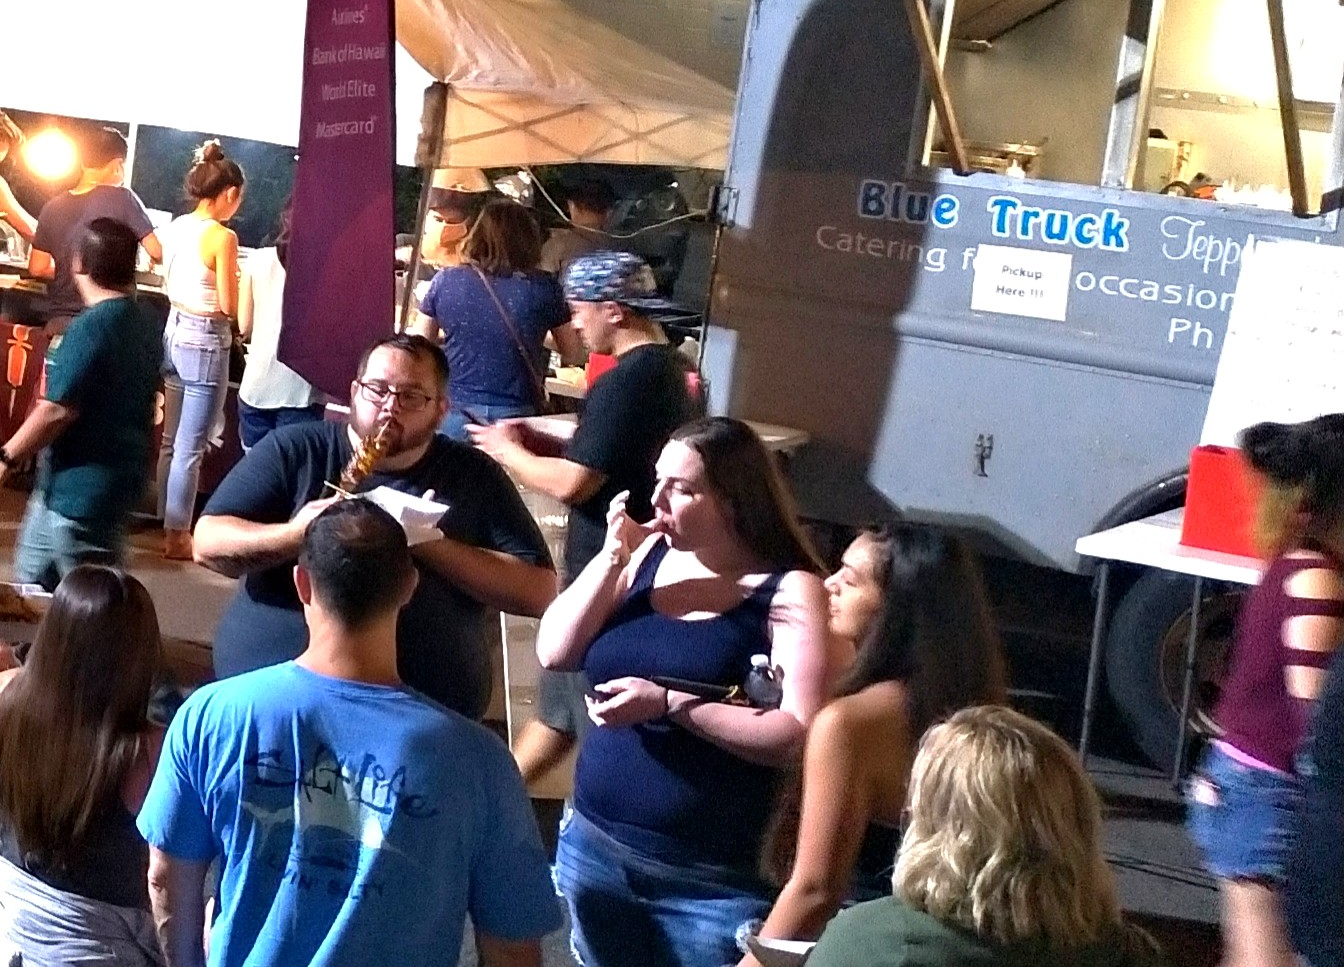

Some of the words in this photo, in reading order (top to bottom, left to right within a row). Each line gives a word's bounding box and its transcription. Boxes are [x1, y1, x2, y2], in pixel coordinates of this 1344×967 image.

[313, 46, 337, 65] Bank
[322, 81, 346, 101] World
[347, 78, 376, 98] Elite
[858, 179, 960, 229] Blue
[987, 194, 1129, 253] Truck
[816, 225, 948, 272] Catering
[1001, 264, 1044, 281] Pickup
[996, 285, 1026, 298] Here
